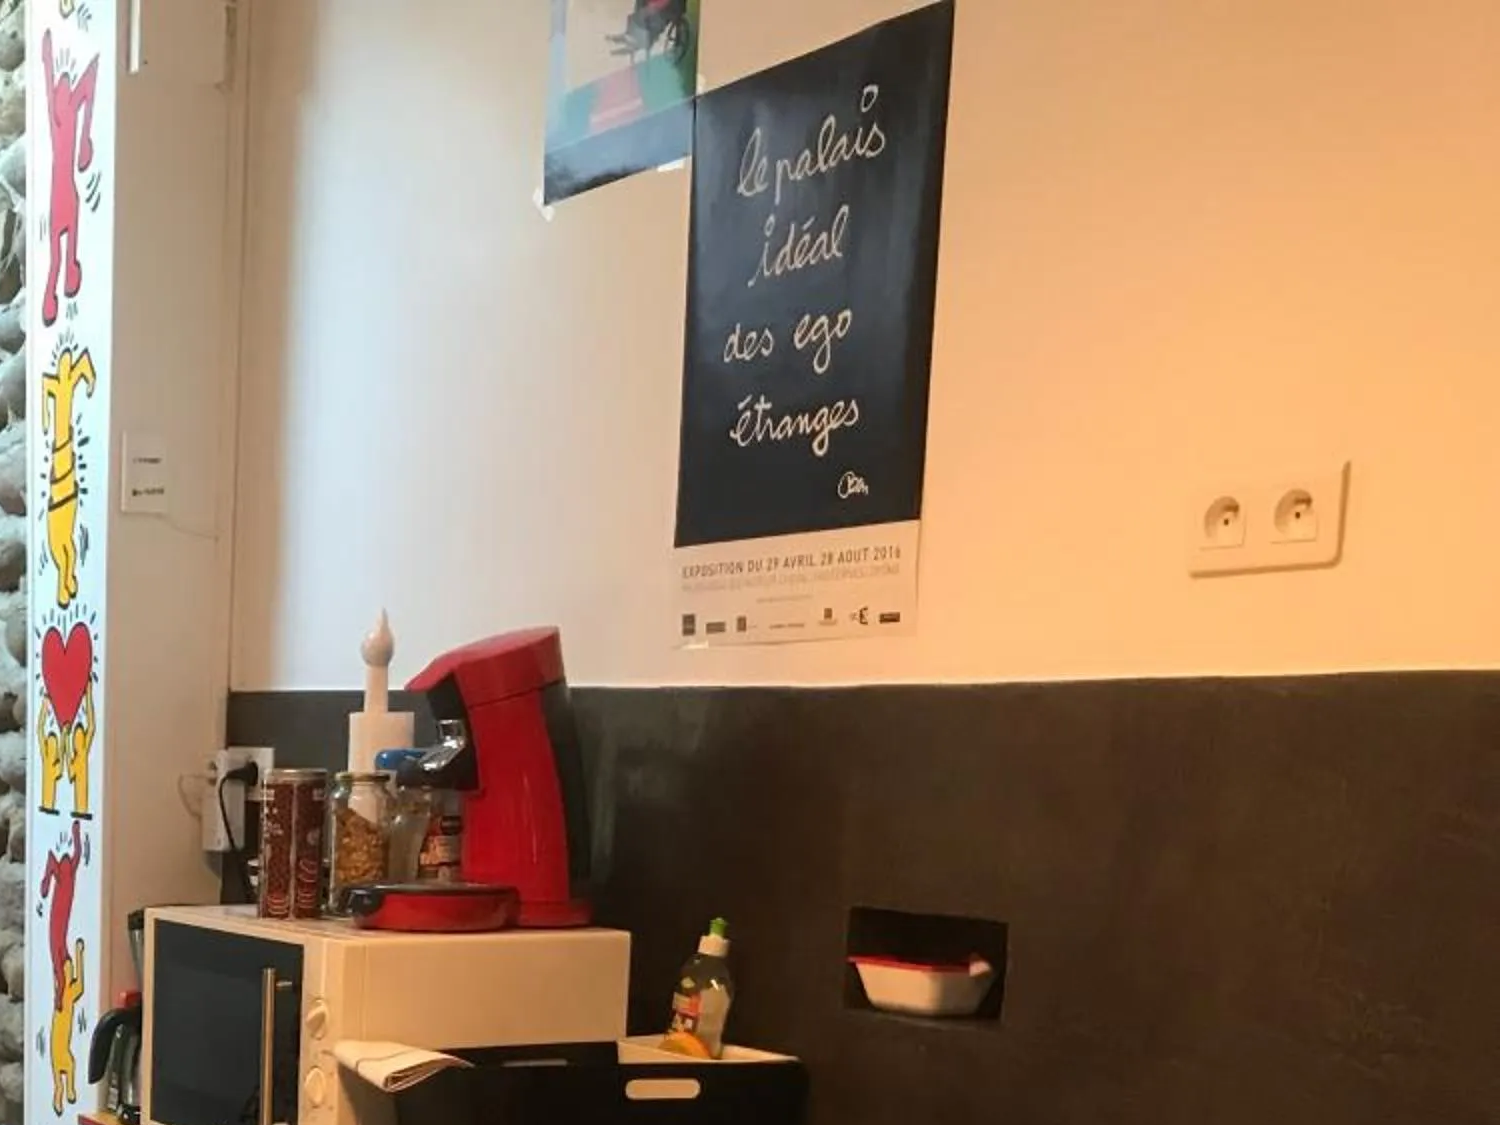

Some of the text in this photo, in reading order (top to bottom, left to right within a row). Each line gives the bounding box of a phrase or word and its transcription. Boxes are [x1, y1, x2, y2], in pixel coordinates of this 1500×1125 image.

[736, 84, 887, 206] le palais
[747, 203, 850, 288] idéal
[723, 308, 854, 375] des ego
[729, 394, 860, 457] étranges
[681, 561, 744, 579] EXPOSITION
[747, 558, 763, 573] DU
[782, 552, 815, 570] AVRIL
